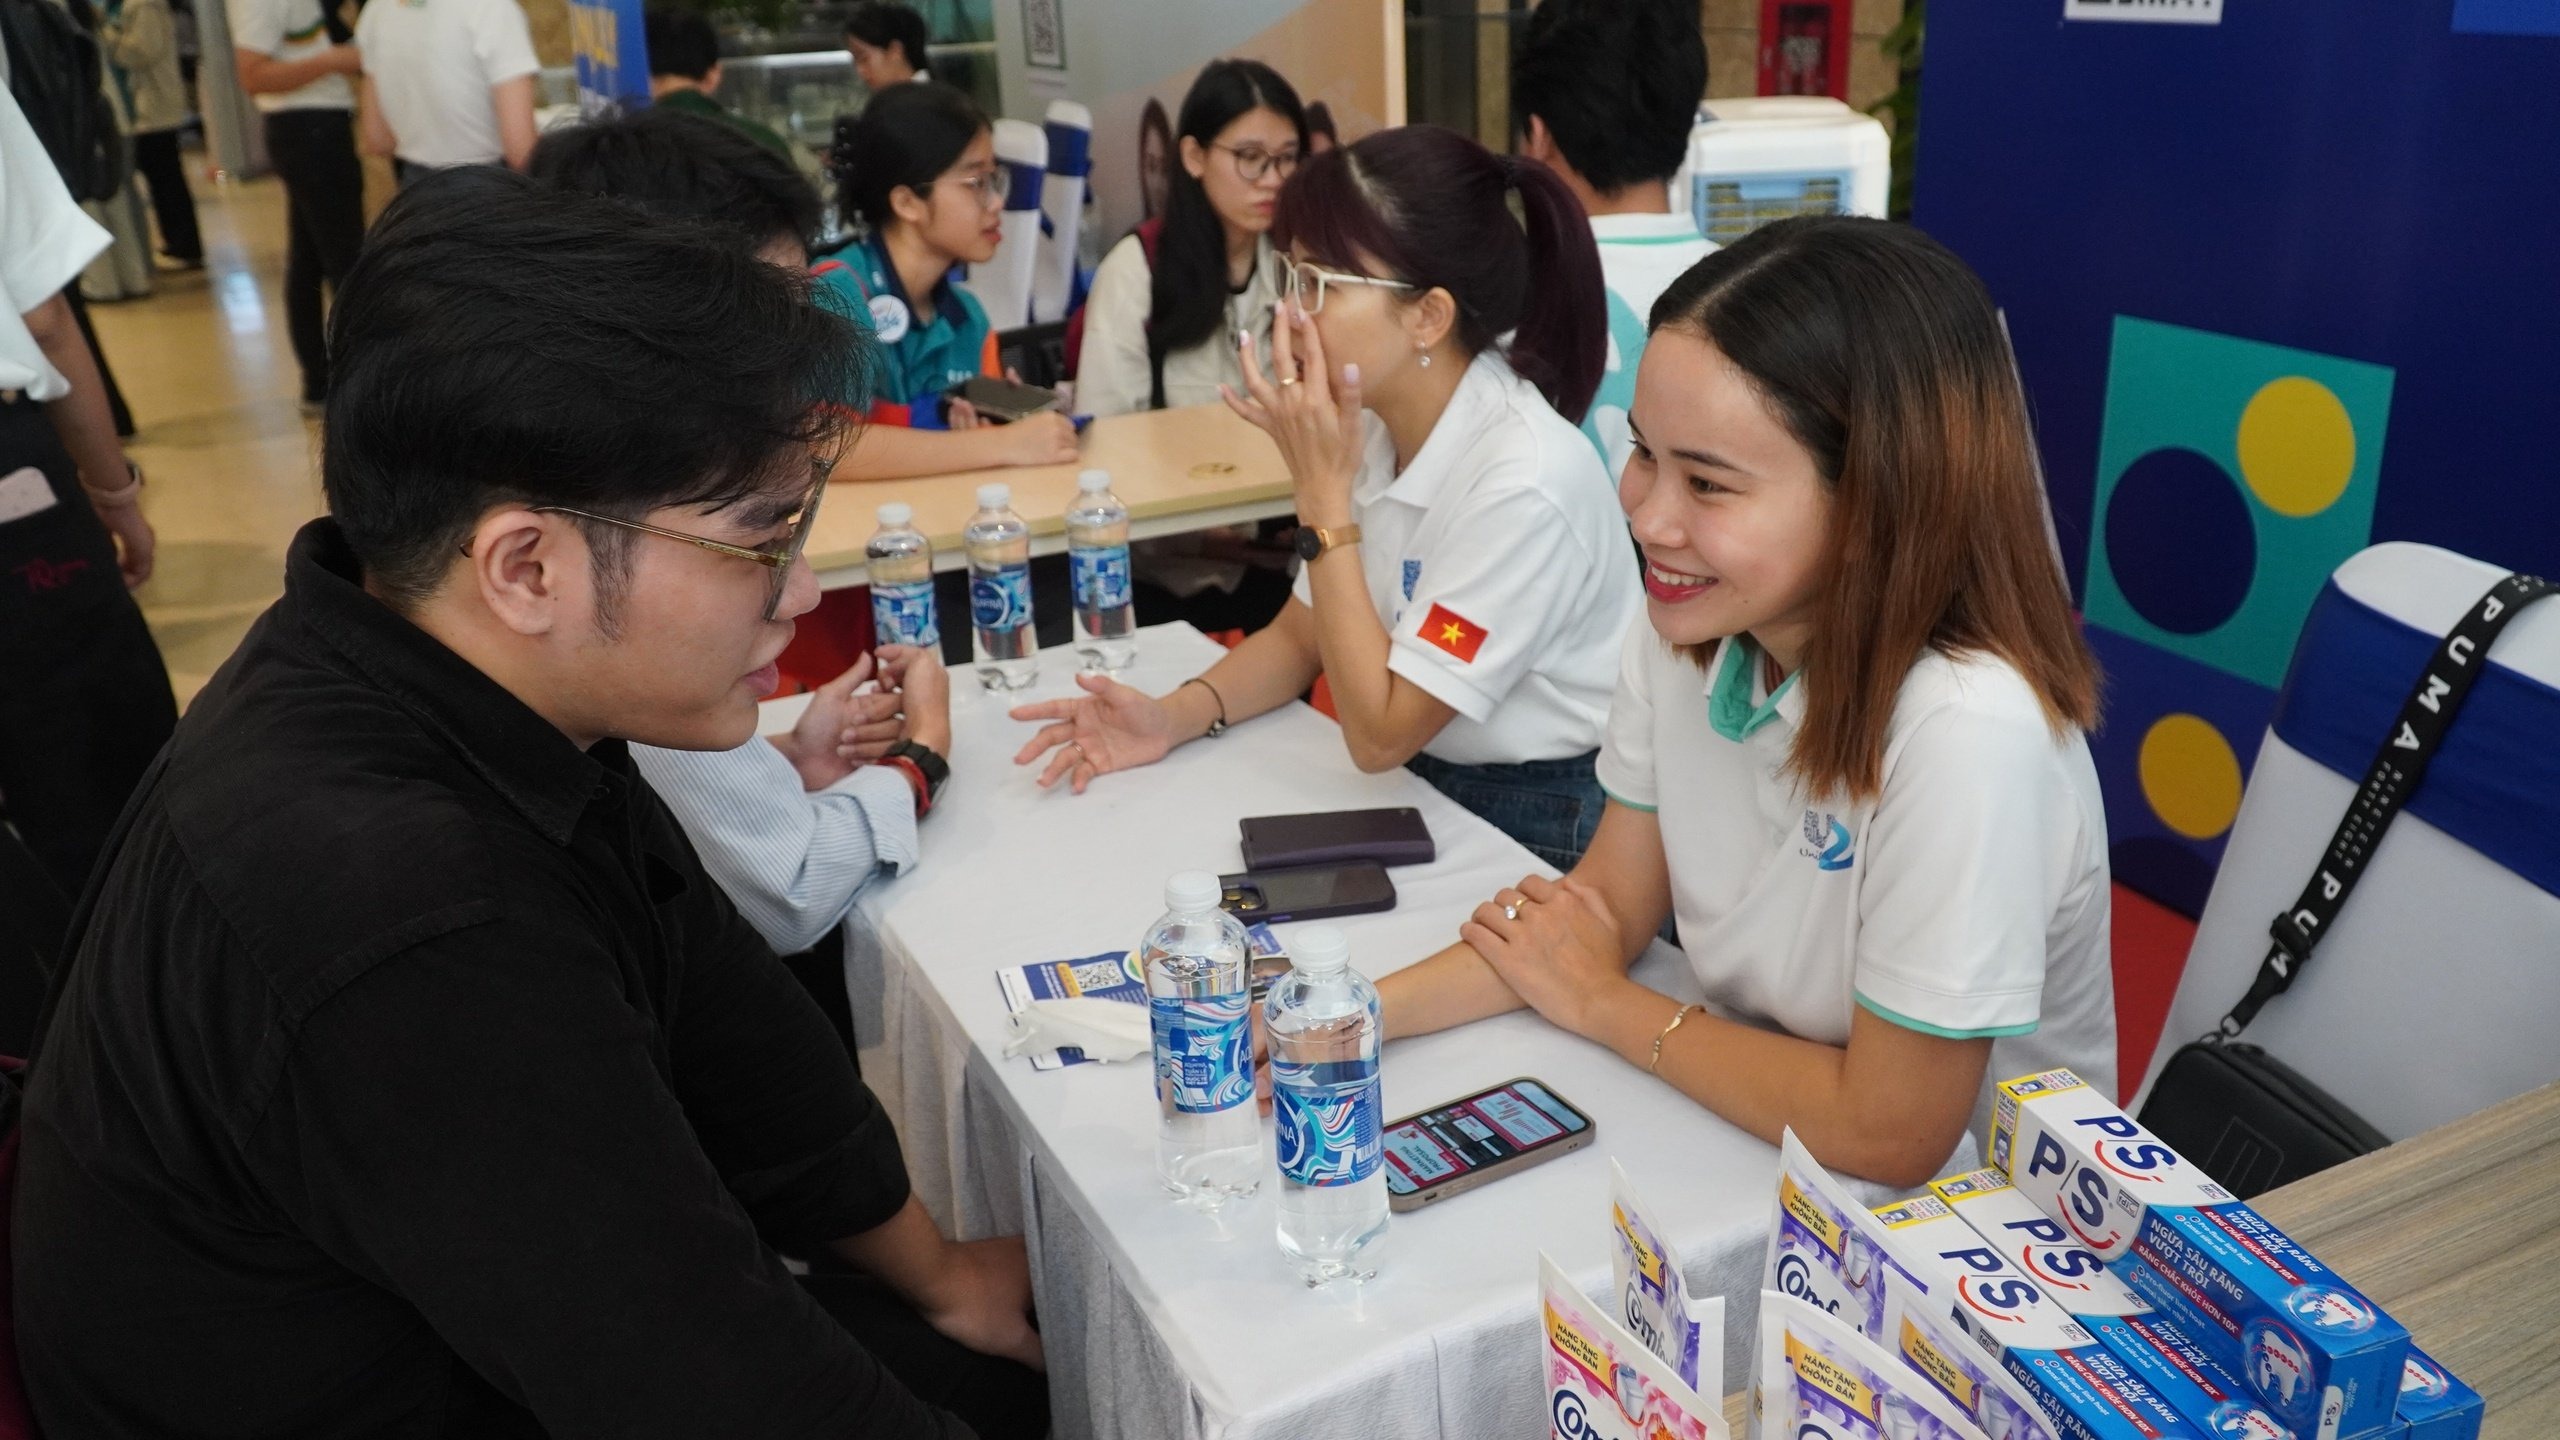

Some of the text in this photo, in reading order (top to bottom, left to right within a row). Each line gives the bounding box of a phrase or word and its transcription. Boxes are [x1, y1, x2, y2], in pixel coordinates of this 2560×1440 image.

[2393, 595, 2505, 751] PUMA
[1400, 1146, 1433, 1175] MARKETING
[2073, 1116, 2177, 1170] P/S
[2029, 1130, 2108, 1227] P/S
[1790, 1202, 1827, 1238] KHÔNG BÁN
[1793, 1193, 1812, 1213] HÀNG
[2003, 1218, 2104, 1277] P/S
[2226, 1213, 2284, 1256] VƯỢT TRỘI
[2236, 1210, 2323, 1272] NGỪA SÂU RĂNG
[1939, 1248, 2040, 1308] P/S
[2138, 1245, 2160, 1265] RĂNG
[2160, 1261, 2182, 1284] CHẮC
[2181, 1281, 2202, 1303] KHỎE
[2202, 1299, 2222, 1320] HƠN
[2149, 1233, 2208, 1289] VƯỢT TRỘI
[2151, 1218, 2244, 1301] NGỪA SÂU RĂNG
[1555, 1333, 1598, 1371] KHÔNG BÁN
[1557, 1323, 1599, 1360] HÀNG TẶNG
[1915, 1338, 1935, 1360] HÀNG
[2151, 1322, 2208, 1367] VƯỢT TRỘI
[1800, 1363, 1856, 1402] KHÔNG BÁN
[1804, 1353, 1857, 1391] HÀNG TẶNG
[1912, 1348, 1956, 1390] KHÔNG BÁN
[2085, 1356, 2142, 1404] VƯỢT TRỘI
[2096, 1353, 2179, 1423] NGỪA SÂU RĂNG
[2010, 1361, 2096, 1440] NGỪA SÂU RĂN
